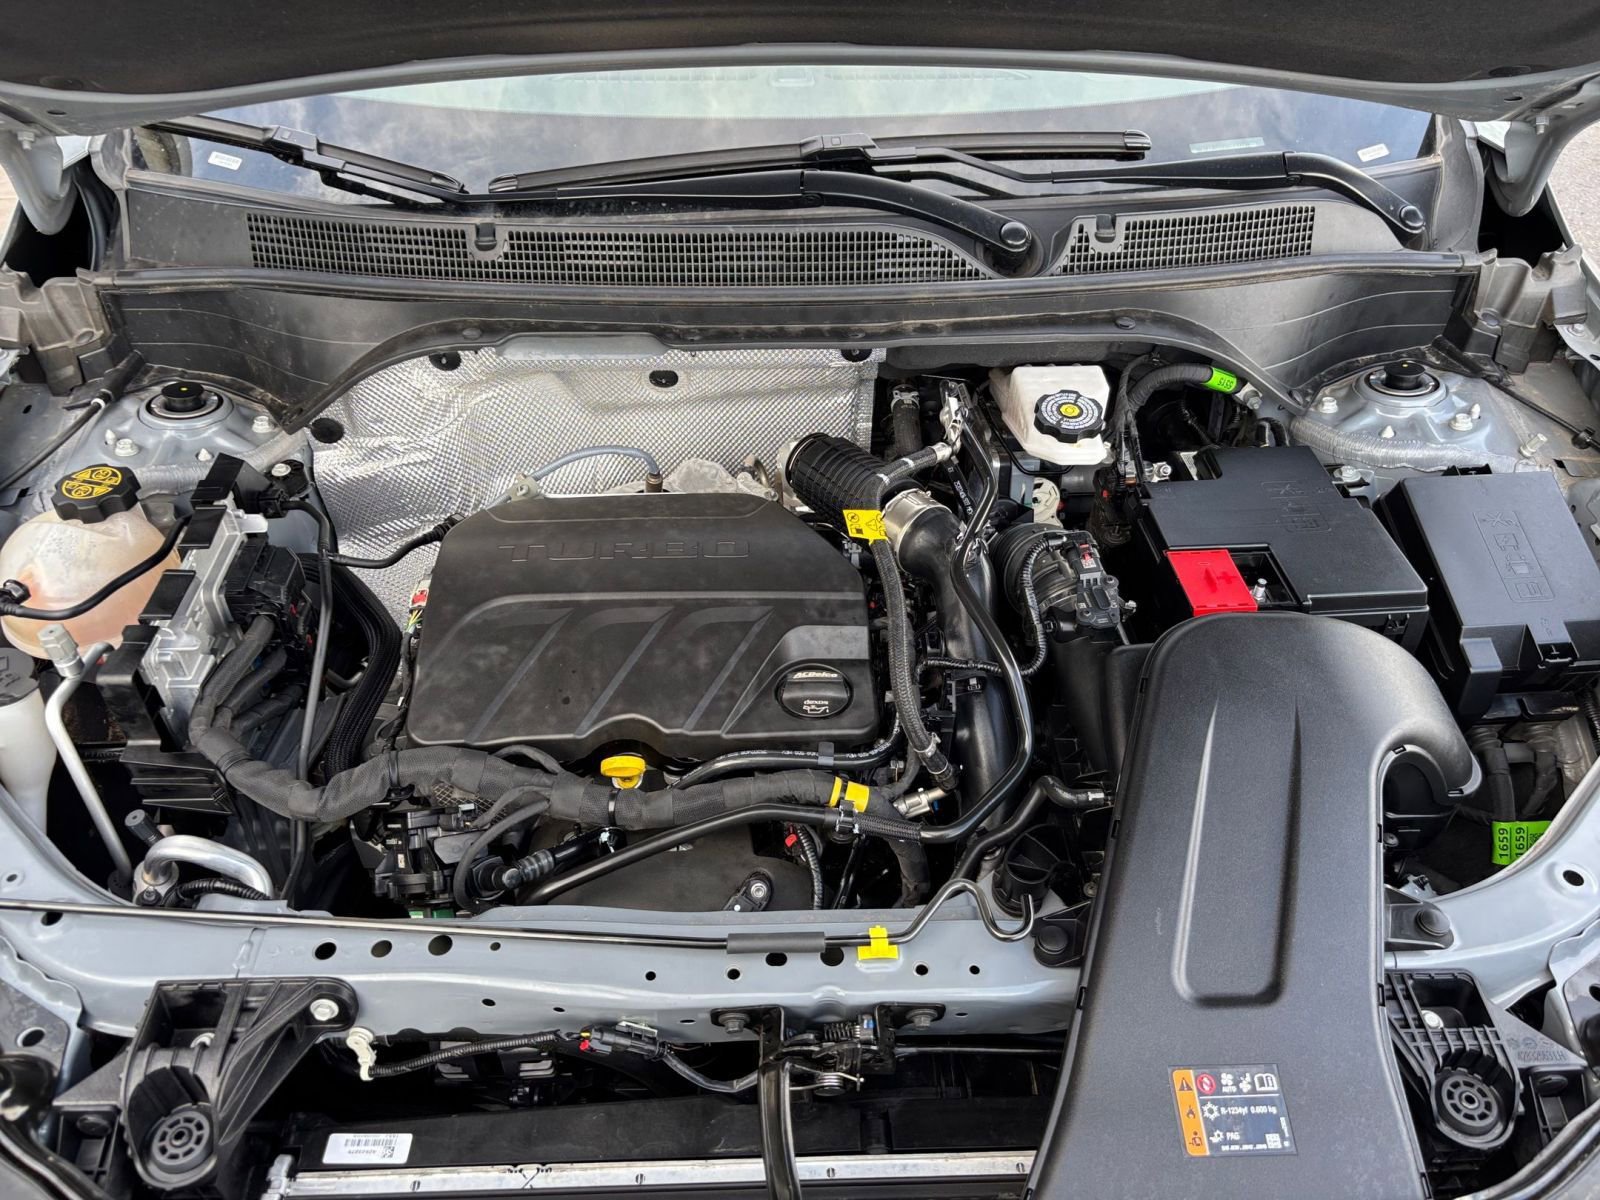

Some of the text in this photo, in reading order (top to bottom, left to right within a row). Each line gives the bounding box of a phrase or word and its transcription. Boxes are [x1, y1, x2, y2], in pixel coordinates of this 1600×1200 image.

[498, 541, 749, 562] TURBO
[792, 671, 838, 679] ACDelco
[1498, 828, 1509, 859] 1659
[1515, 827, 1525, 857] 1659
[1222, 1085, 1237, 1093] AUTO
[1268, 1105, 1278, 1115] kg
[1226, 1131, 1241, 1141] PAG
